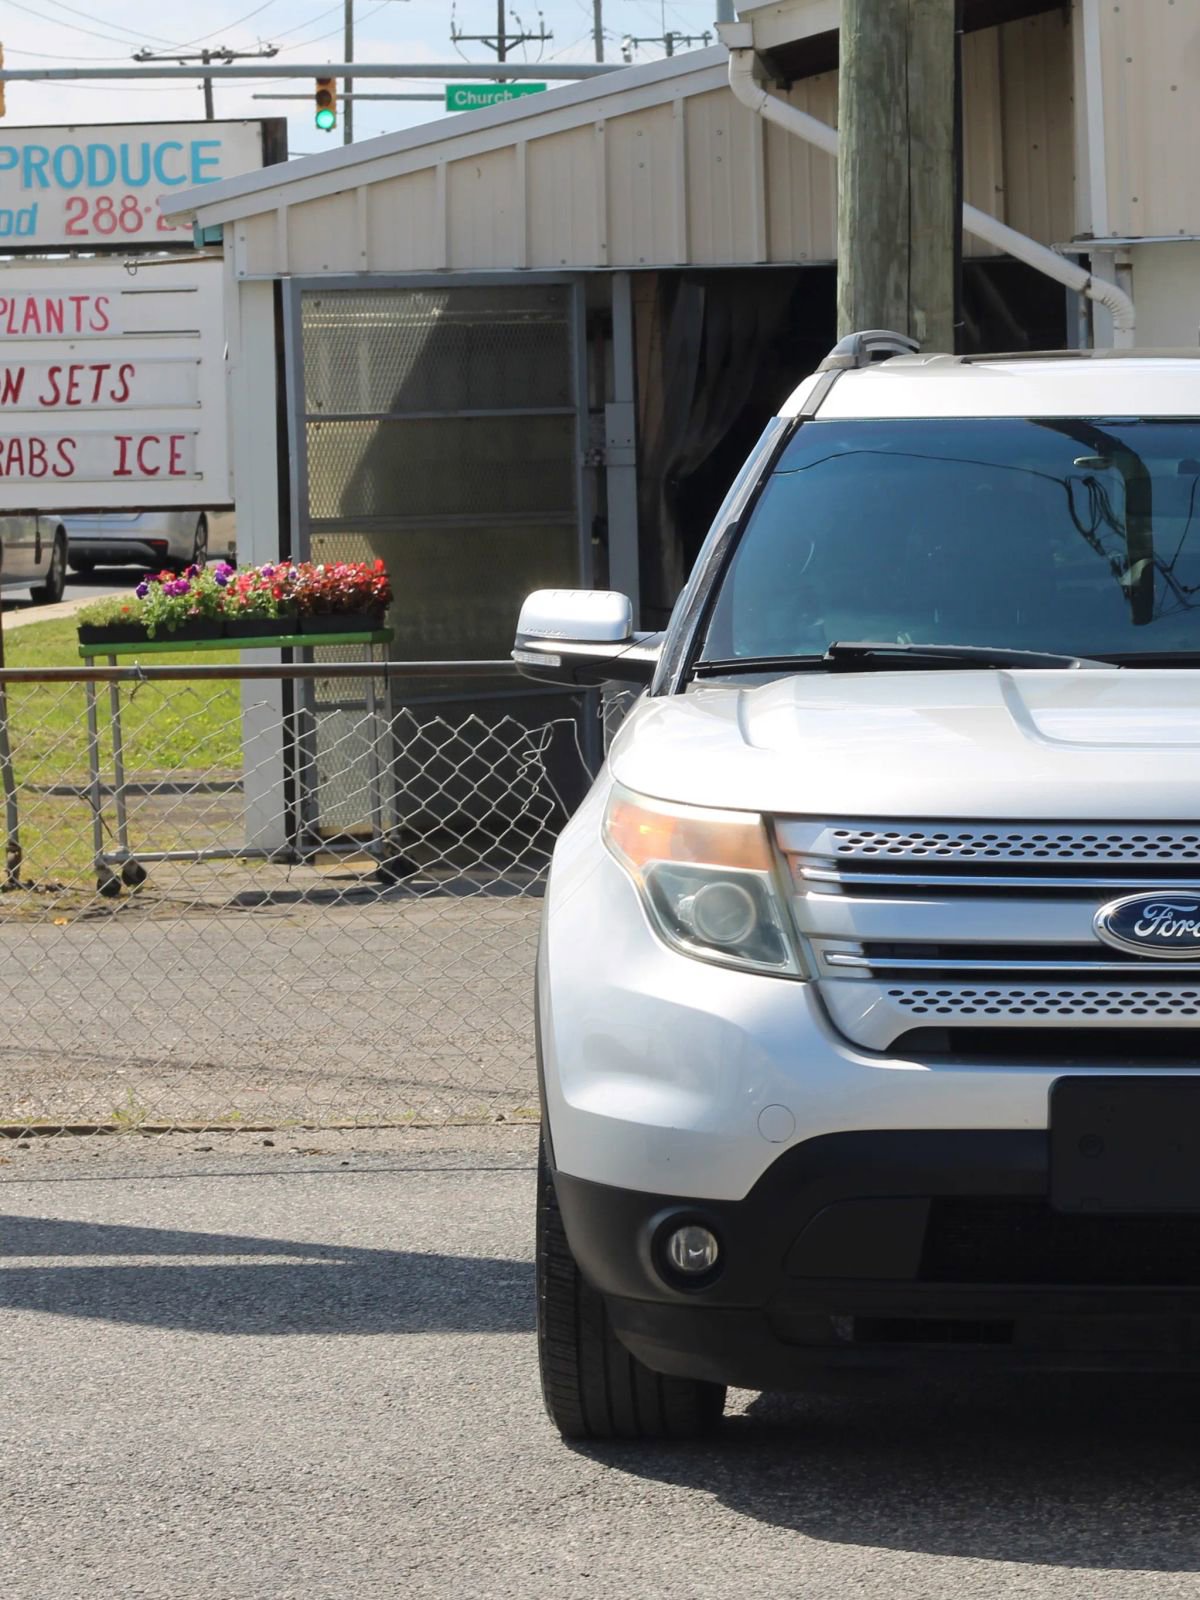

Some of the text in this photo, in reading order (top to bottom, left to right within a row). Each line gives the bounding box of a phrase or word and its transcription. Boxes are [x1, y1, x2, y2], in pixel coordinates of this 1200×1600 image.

[455, 90, 513, 105] Church
[0, 140, 223, 189] PRODUCE
[38, 363, 135, 407] SETS
[113, 434, 187, 476] ICE
